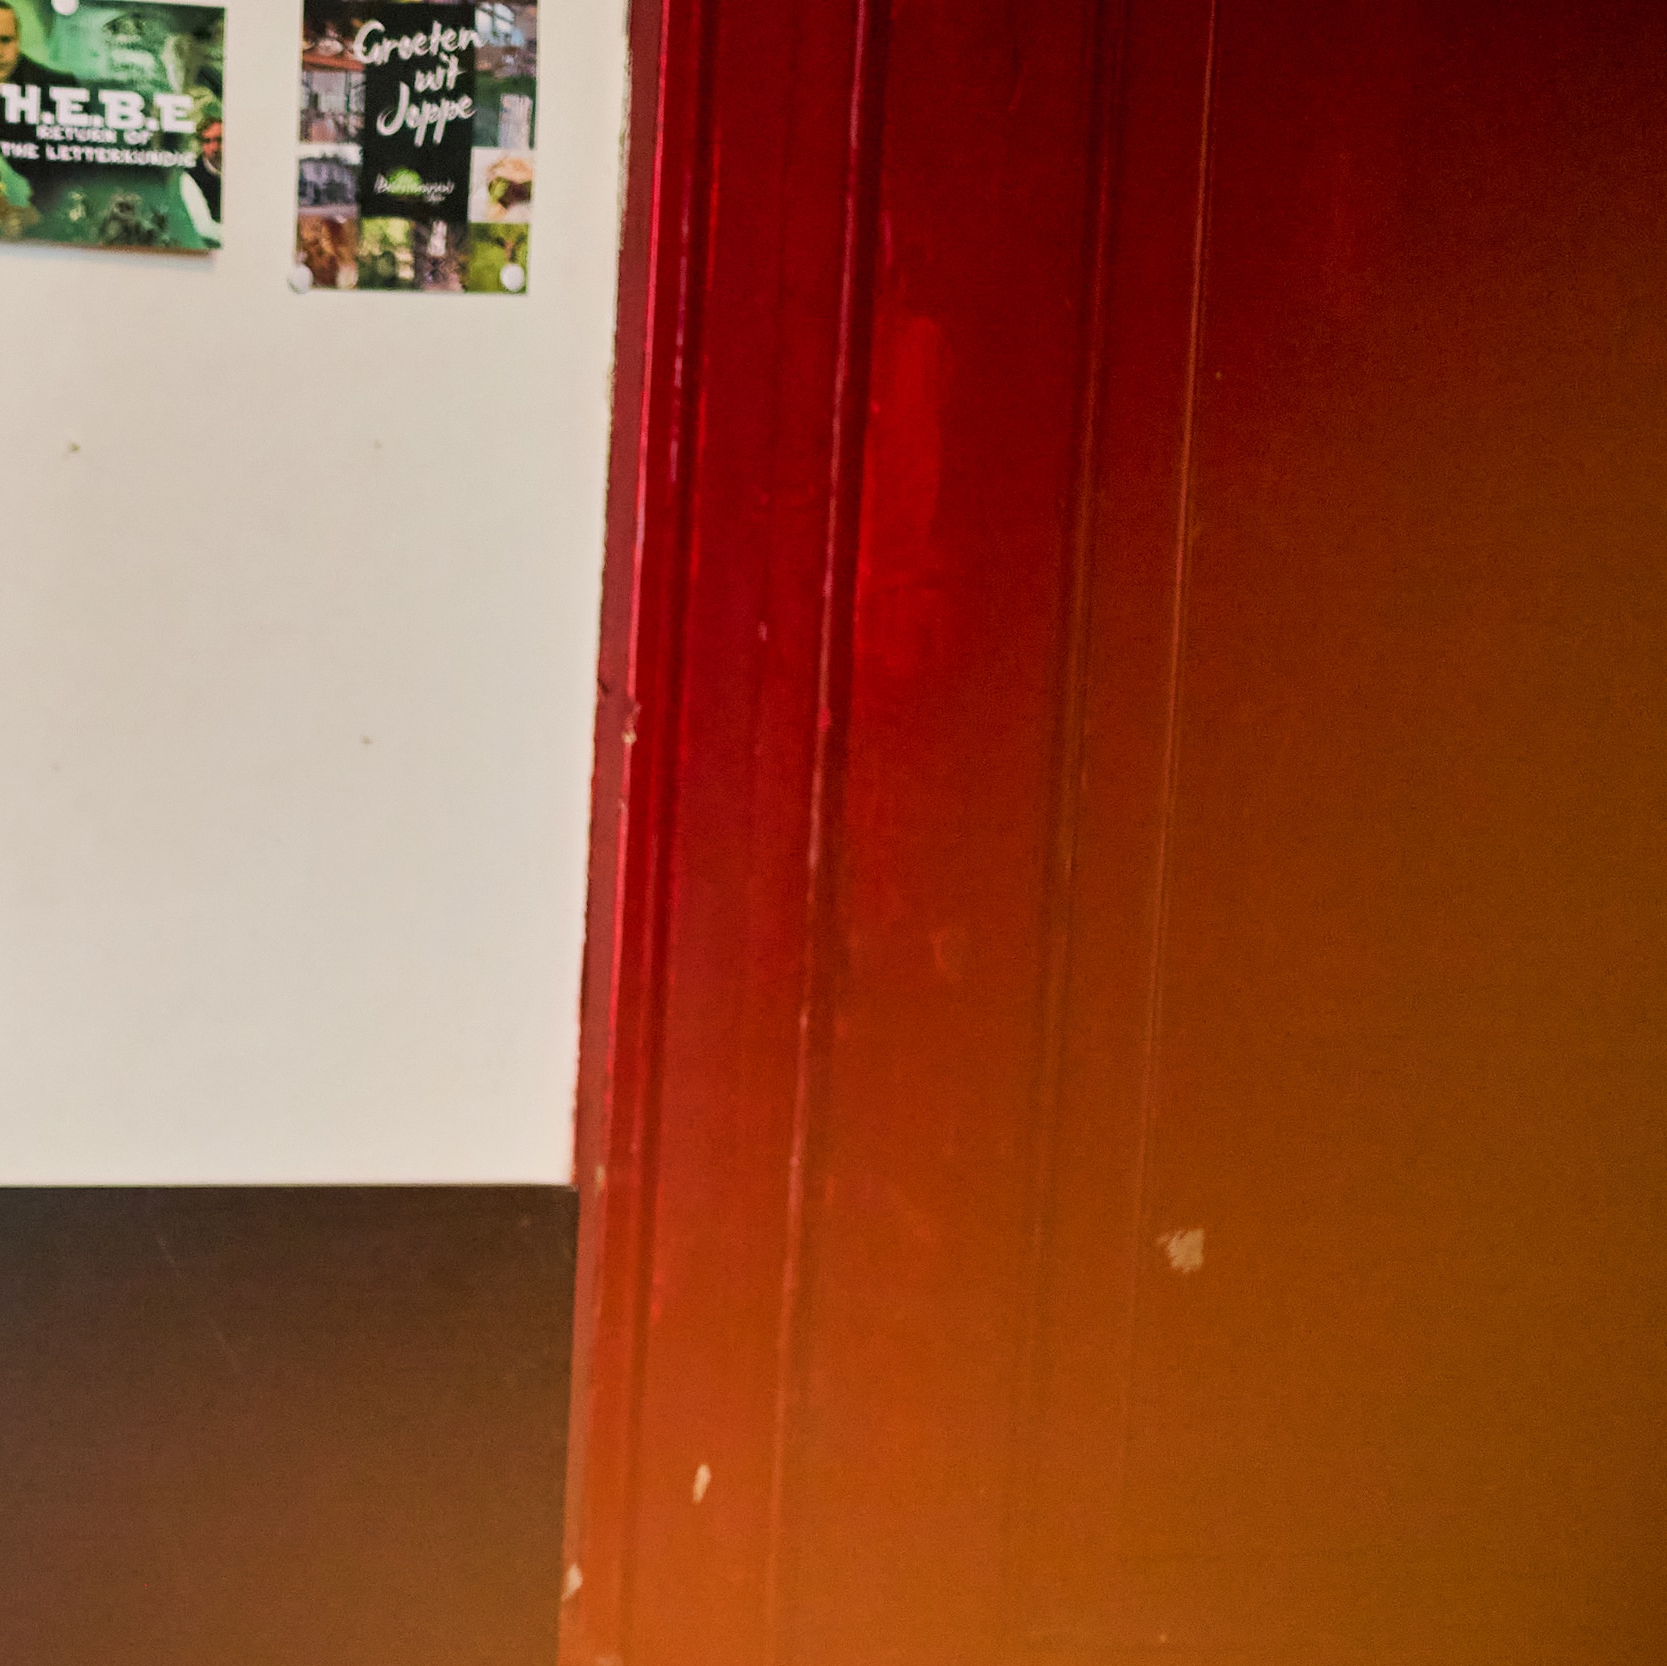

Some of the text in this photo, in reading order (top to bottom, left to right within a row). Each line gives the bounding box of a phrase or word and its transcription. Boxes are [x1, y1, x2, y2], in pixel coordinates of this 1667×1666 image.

[353, 19, 486, 66] Groeten
[36, 124, 154, 145] RETURN OF
[376, 81, 478, 147] Joppe
